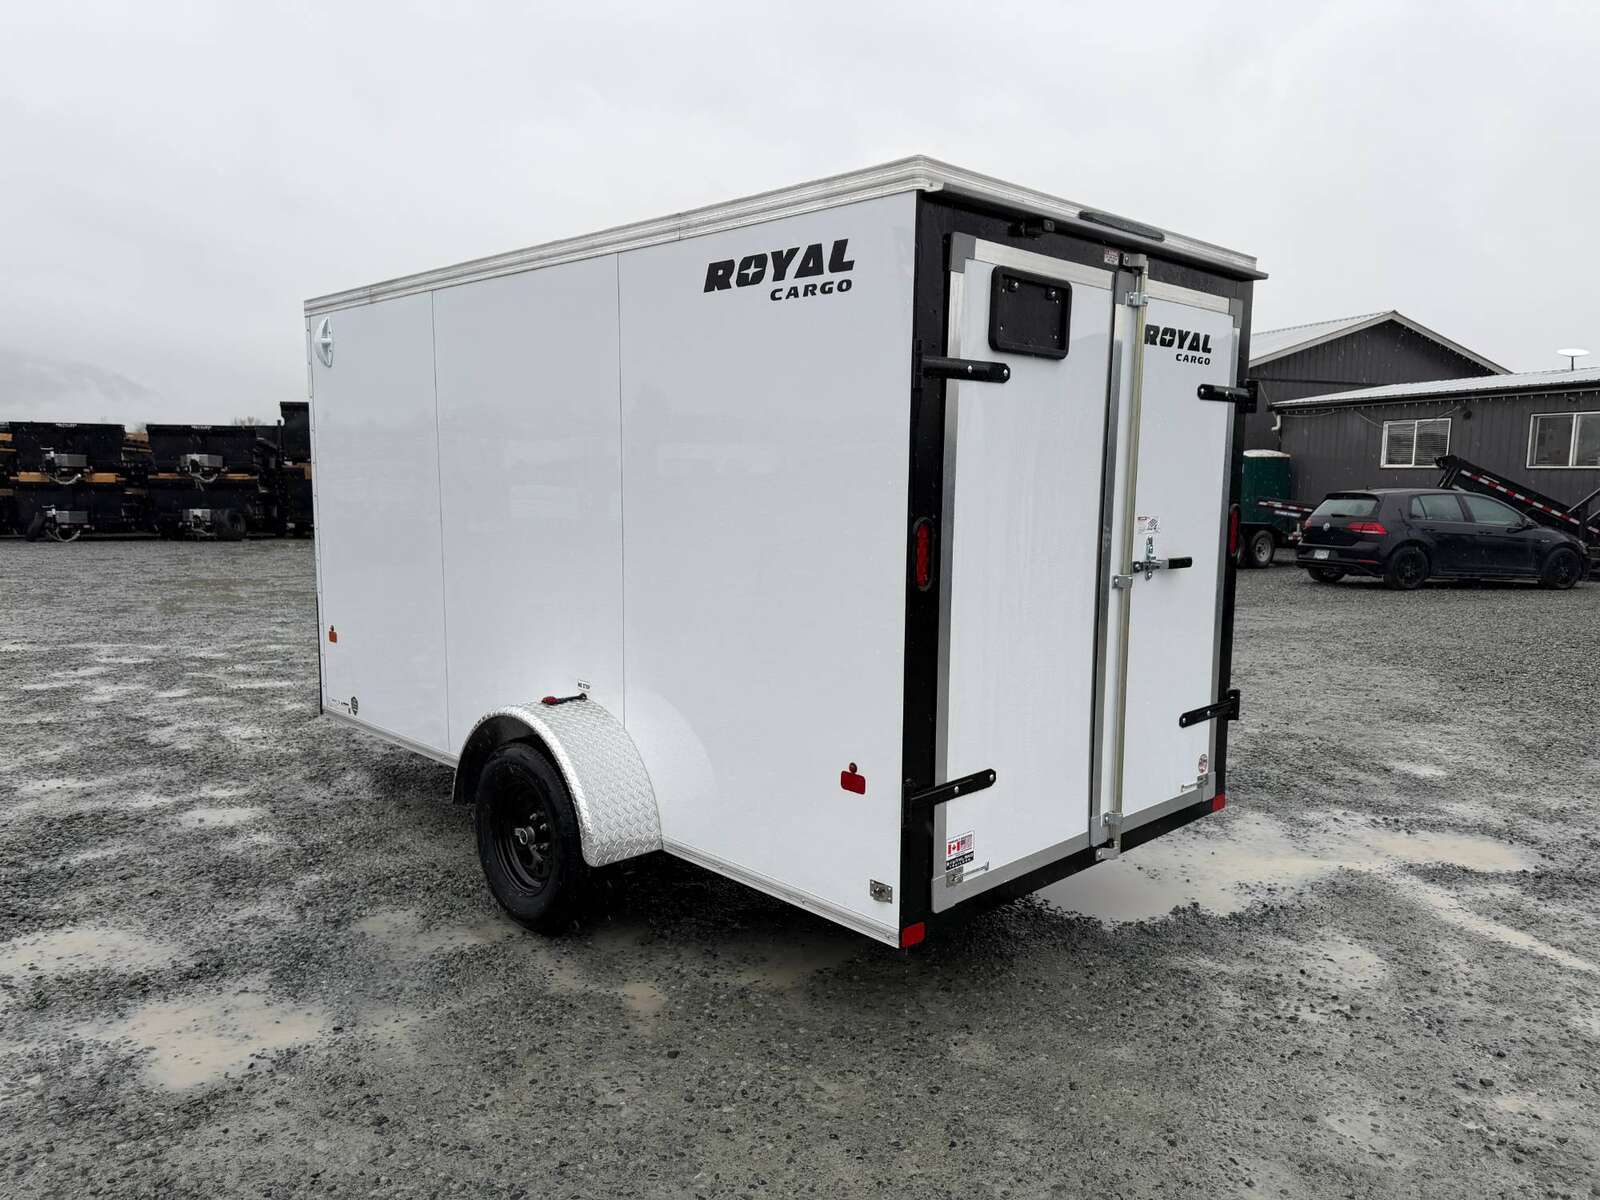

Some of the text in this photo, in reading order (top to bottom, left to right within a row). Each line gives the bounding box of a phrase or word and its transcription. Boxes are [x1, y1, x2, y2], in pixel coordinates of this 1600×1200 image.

[703, 238, 855, 293] ROYAL
[769, 278, 853, 302] CARGO
[1144, 323, 1212, 354] ROYAL
[1175, 353, 1211, 366] CARGO
